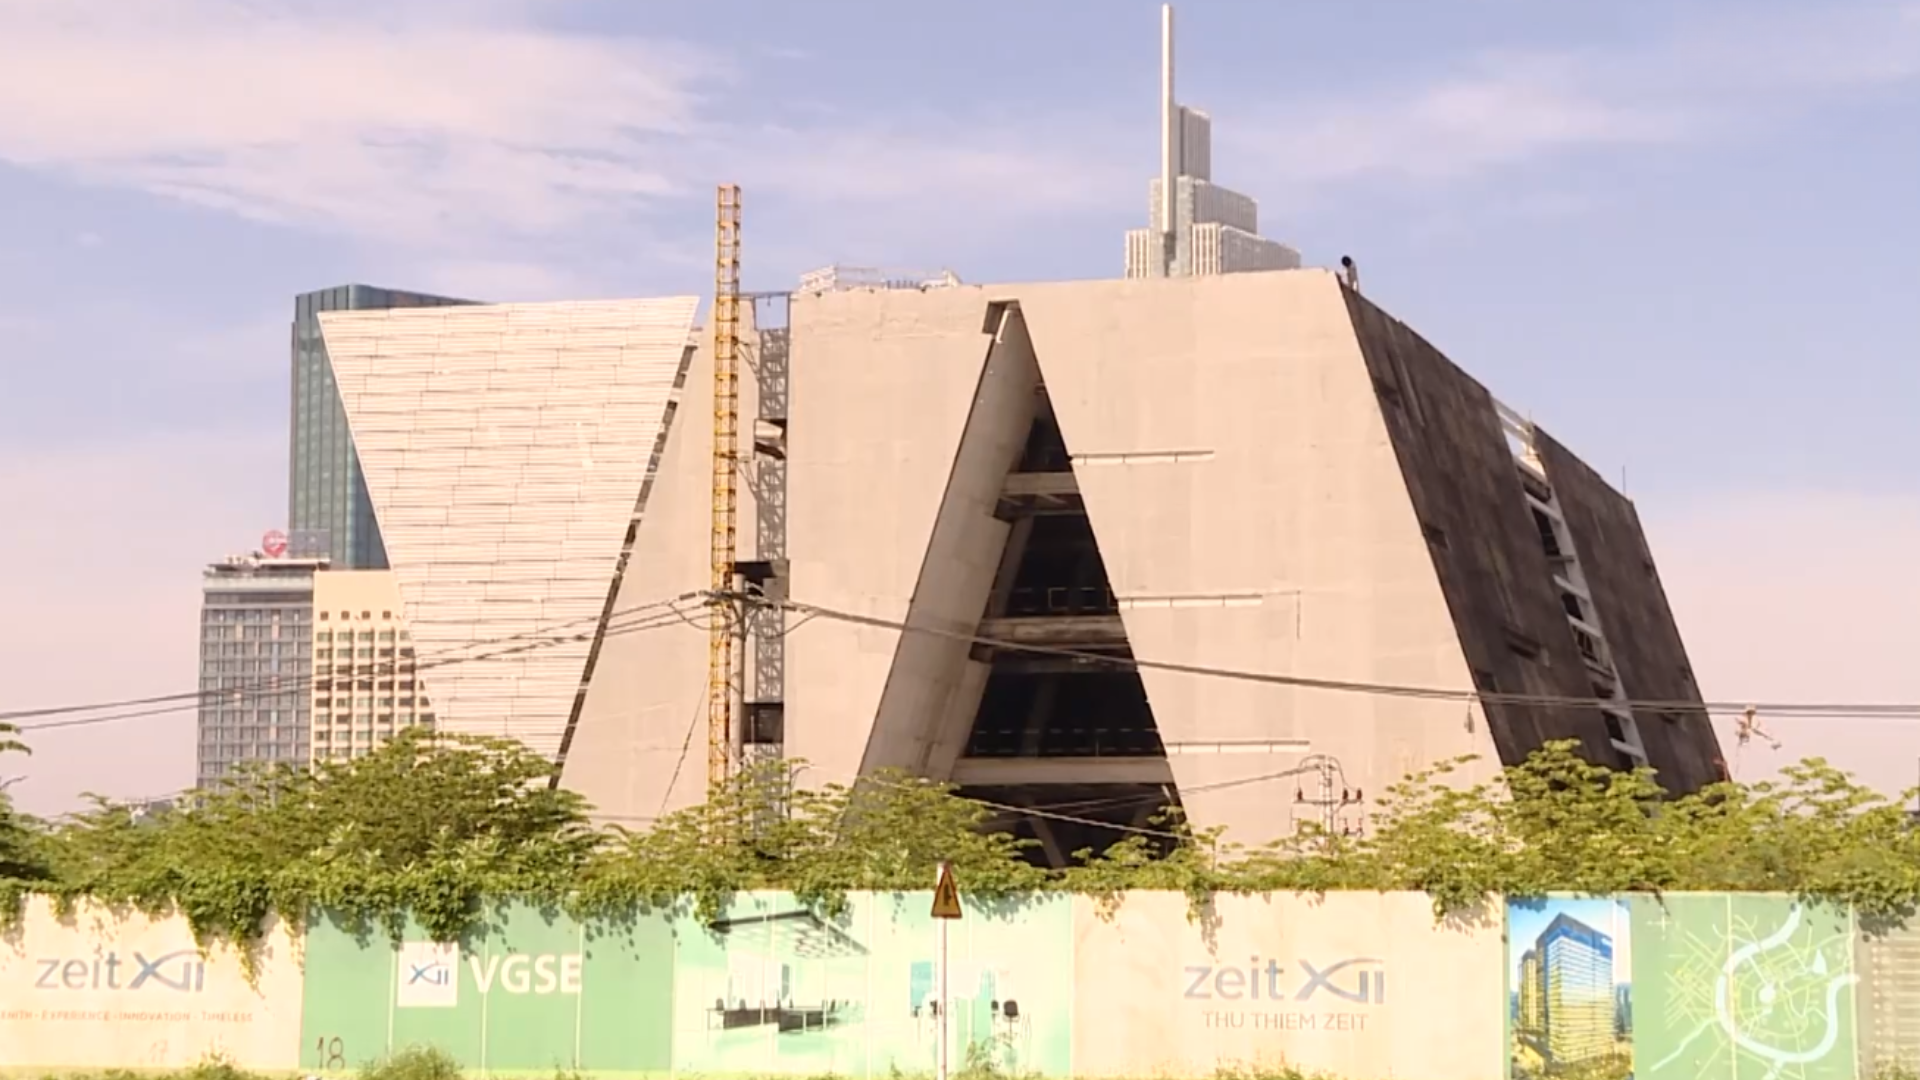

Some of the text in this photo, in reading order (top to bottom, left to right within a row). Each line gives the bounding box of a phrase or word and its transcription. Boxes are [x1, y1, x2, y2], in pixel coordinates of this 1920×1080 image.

[34, 951, 122, 990] zeit
[470, 952, 583, 995] VGSE
[1184, 955, 1285, 1001] zeit
[118, 1011, 191, 1021] INNOVATION
[201, 1011, 253, 1022] TIMELESS
[1203, 1010, 1369, 1032] THU THIEM ZEIT
[317, 1036, 345, 1070] 18
